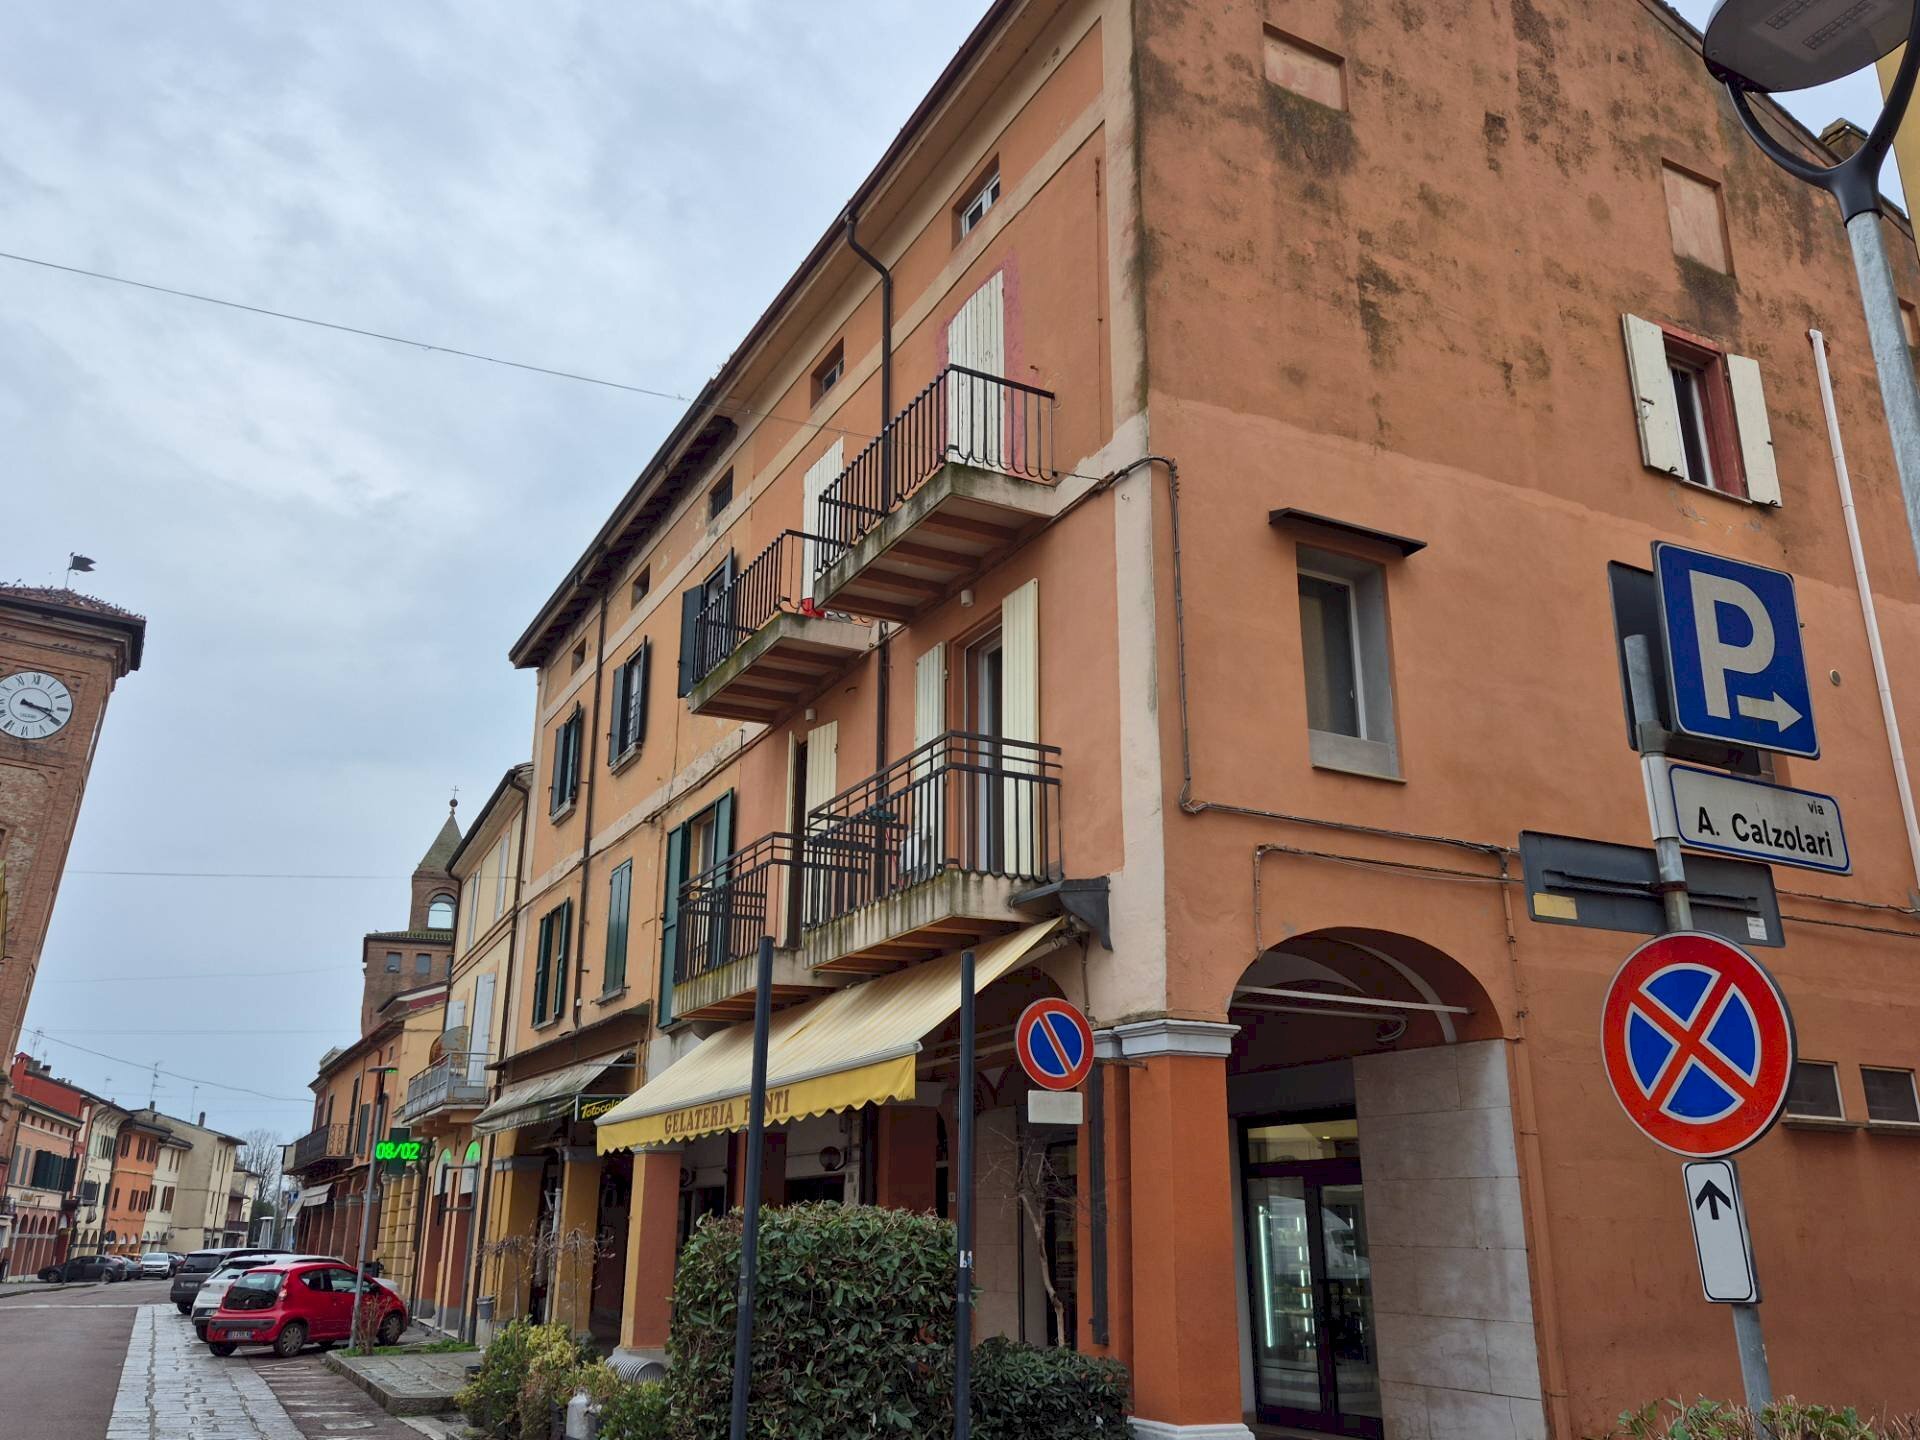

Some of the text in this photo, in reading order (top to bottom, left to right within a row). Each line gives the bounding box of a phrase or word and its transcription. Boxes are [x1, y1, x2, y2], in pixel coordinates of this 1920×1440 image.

[1689, 569, 1775, 719] P
[1807, 800, 1825, 816] via
[1698, 806, 1834, 858] A. Calzolari
[580, 1097, 622, 1119] Totocalc
[664, 1089, 790, 1135] GELATERIA PNTI
[376, 1142, 420, 1160] 08/02
